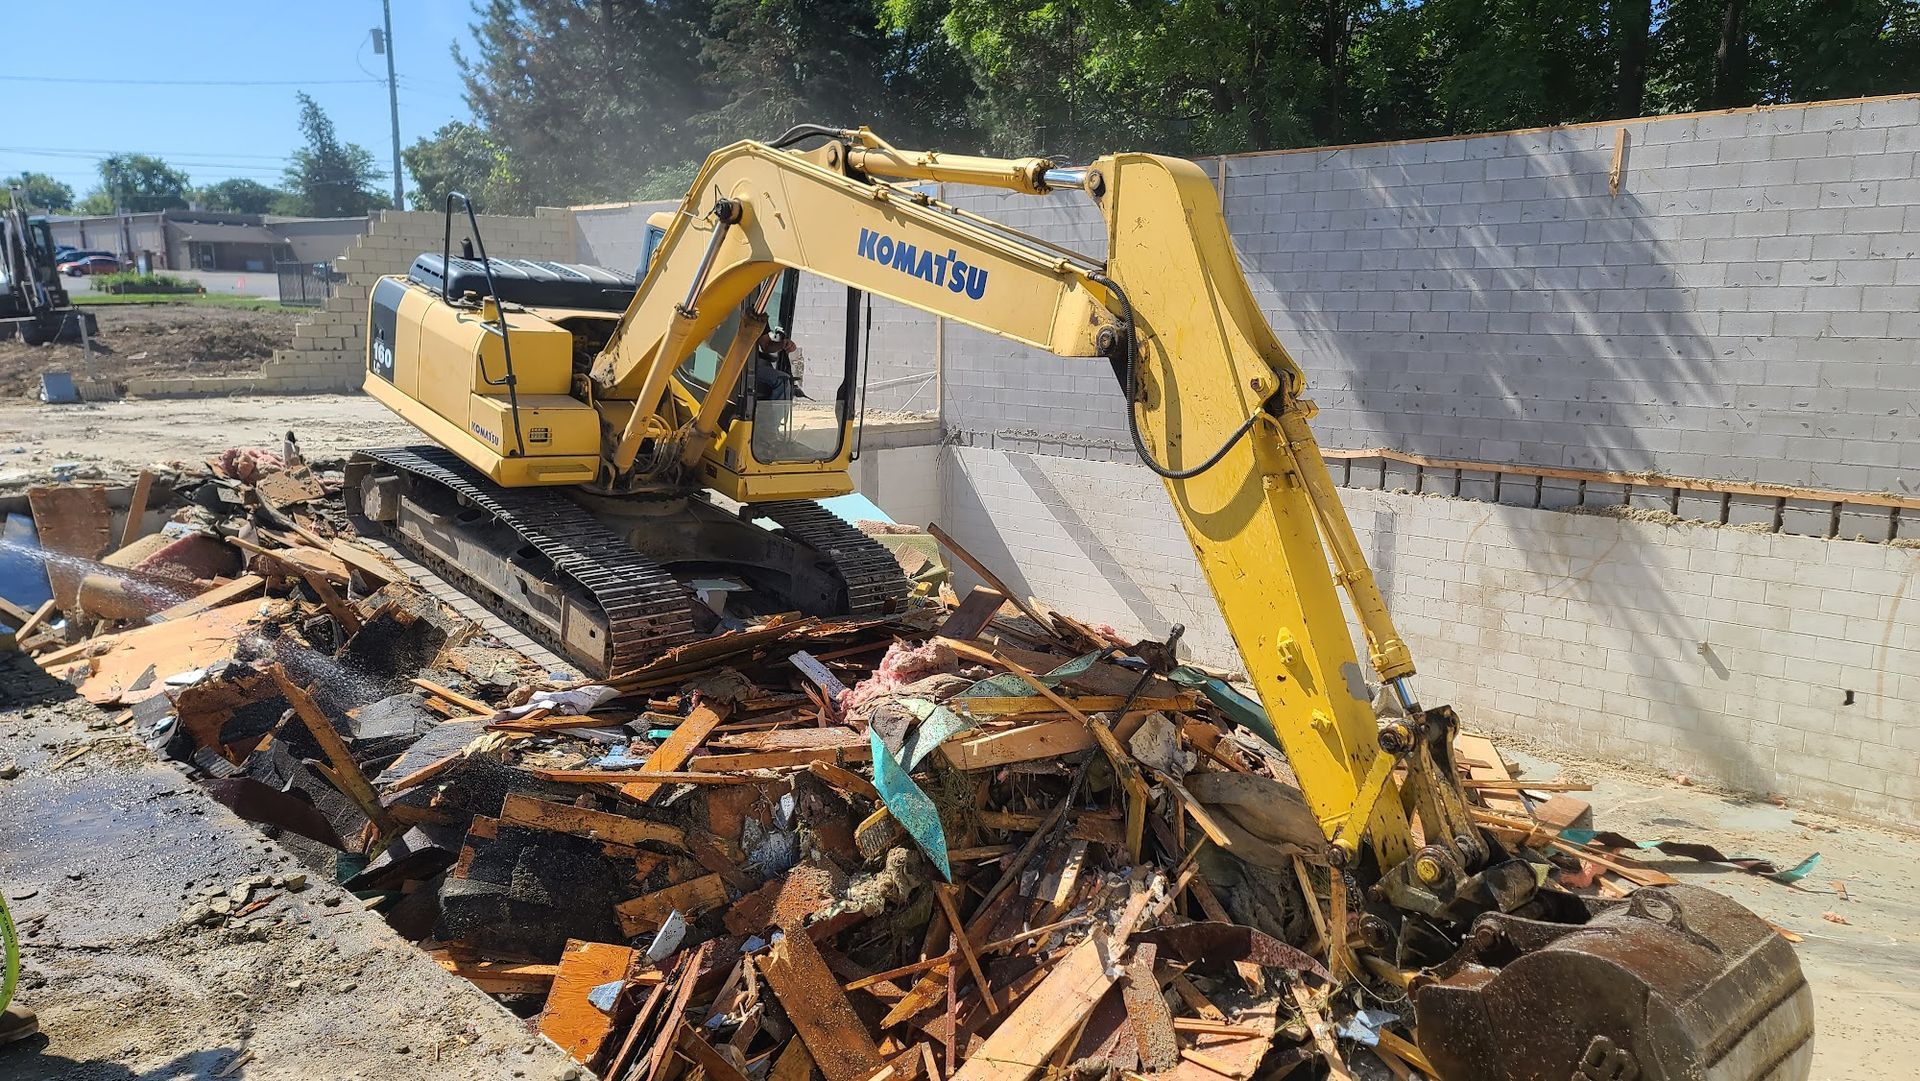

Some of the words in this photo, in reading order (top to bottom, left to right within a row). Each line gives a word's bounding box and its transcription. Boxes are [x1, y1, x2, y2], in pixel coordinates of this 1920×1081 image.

[857, 227, 988, 300] KOMATSU
[373, 341, 392, 369] 160
[471, 421, 499, 446] KOMATSU
